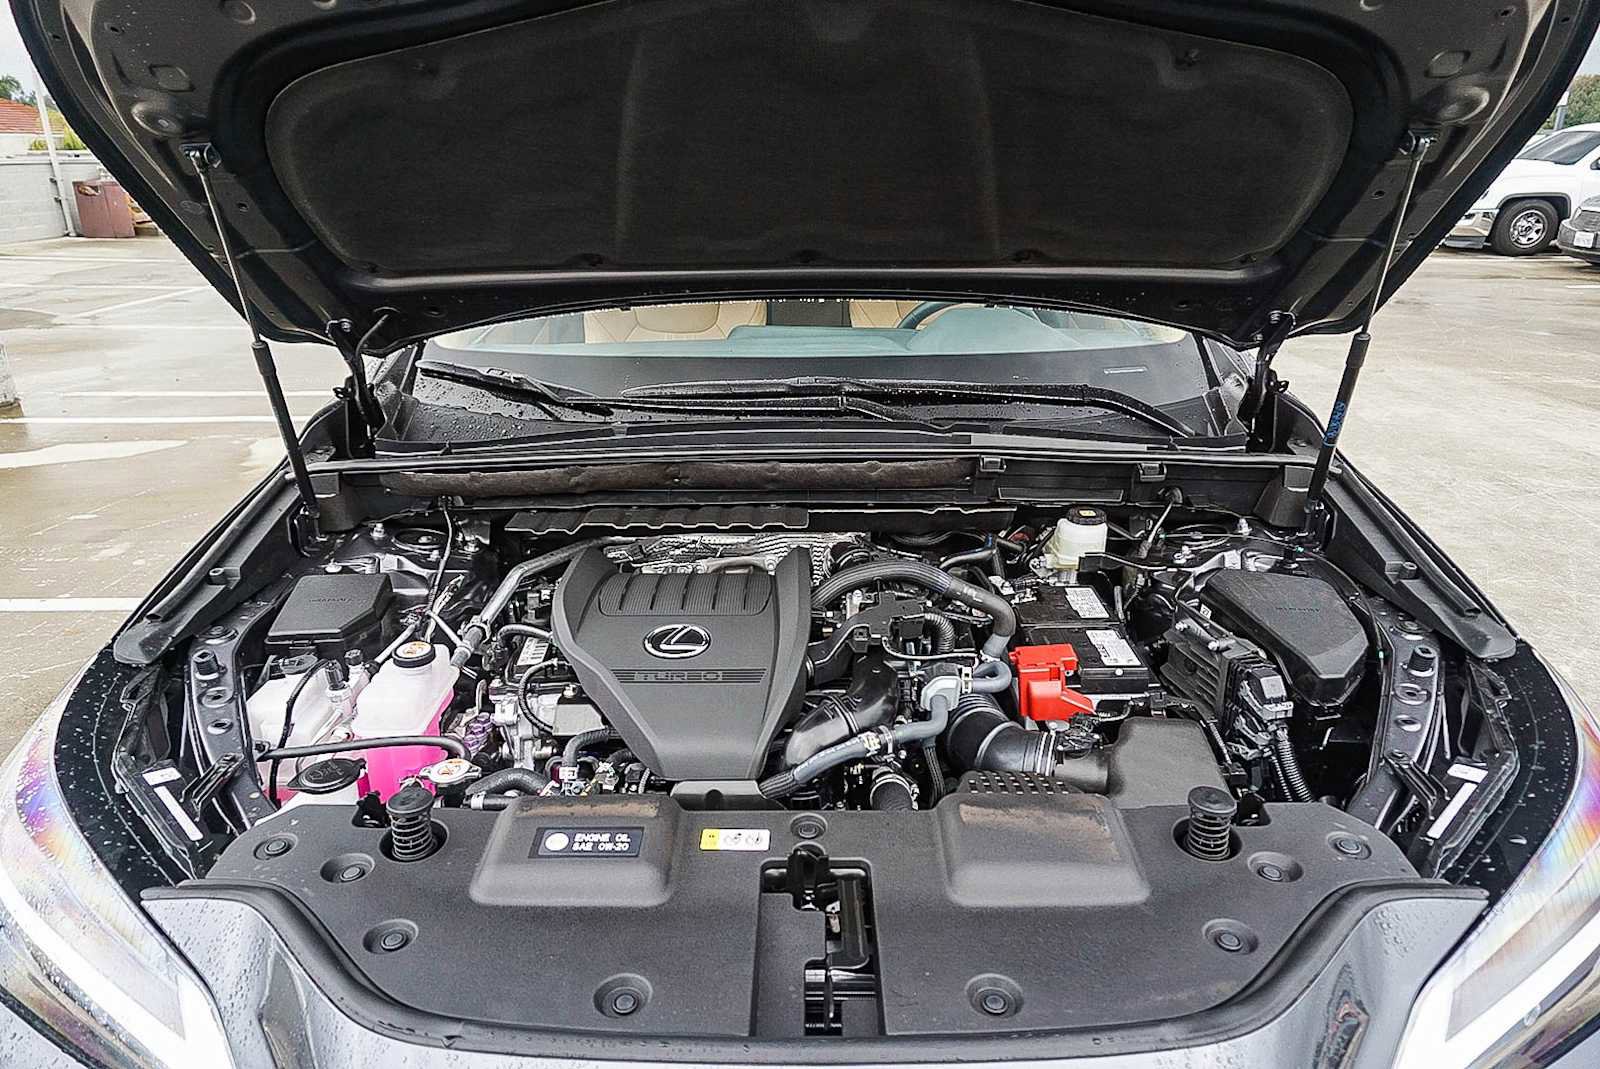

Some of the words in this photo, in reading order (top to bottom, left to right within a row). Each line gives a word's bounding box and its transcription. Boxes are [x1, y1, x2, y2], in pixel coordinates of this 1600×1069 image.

[633, 670, 722, 682] TURBO
[574, 832, 611, 842] ENGINE
[615, 832, 631, 842] OIL
[571, 841, 594, 851] SAE
[597, 841, 630, 851] 0W-20
